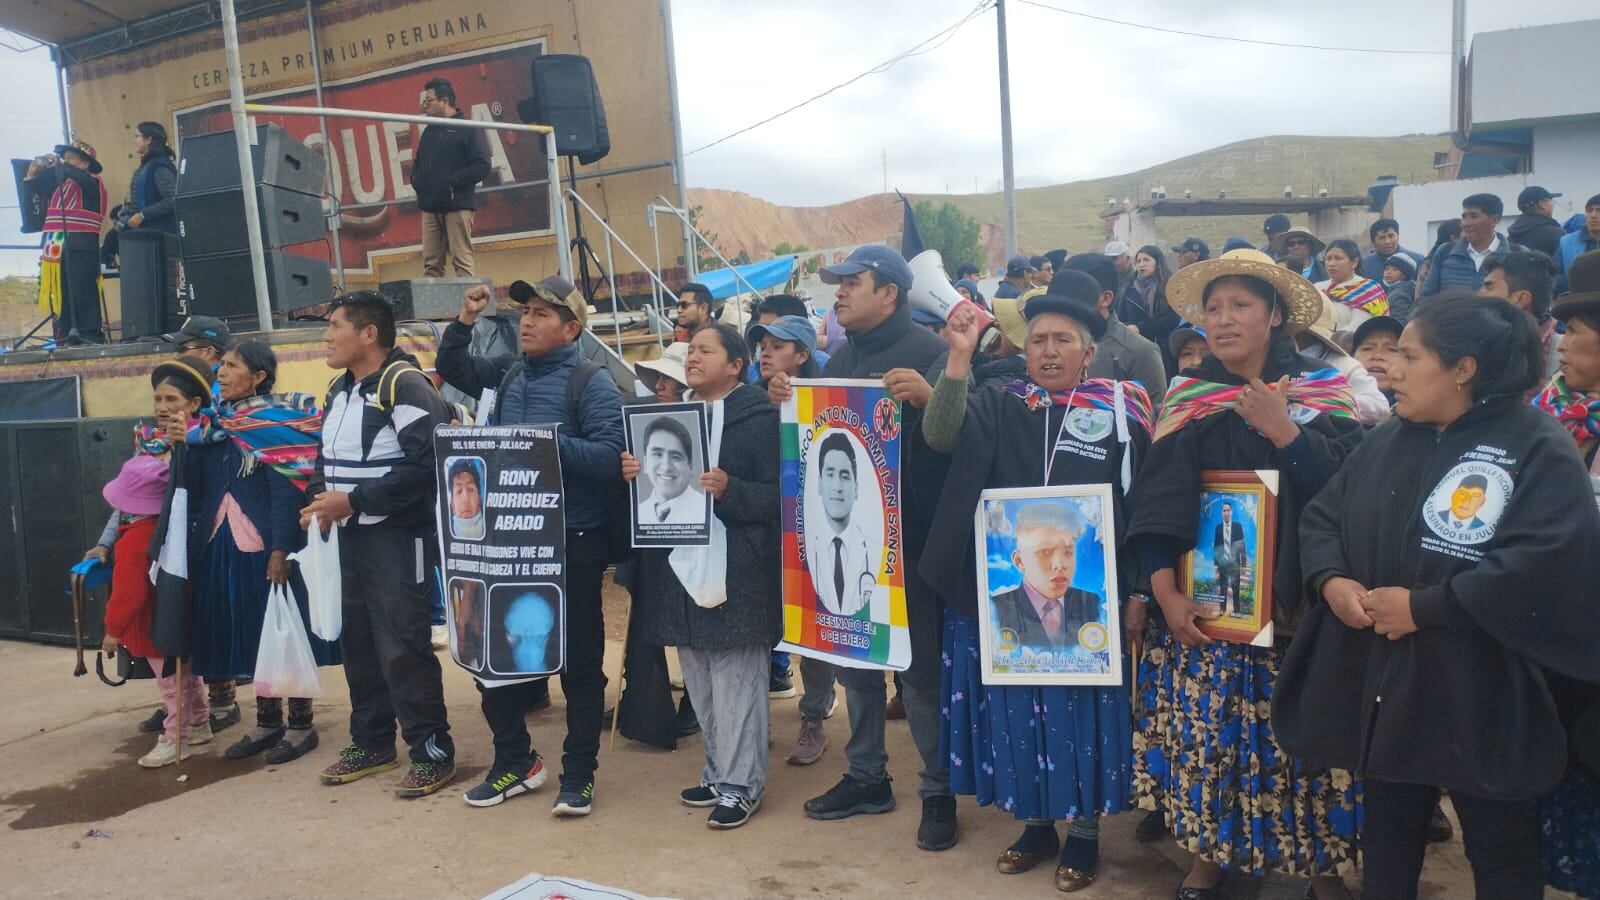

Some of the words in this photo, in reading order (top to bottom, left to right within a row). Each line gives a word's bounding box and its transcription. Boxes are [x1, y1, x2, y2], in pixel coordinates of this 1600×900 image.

[193, 60, 270, 89] CEREZA
[386, 13, 487, 49] PERUANA
[519, 428, 554, 440] VICTIMAS
[452, 441, 463, 450] DEL
[467, 441, 476, 450] DE
[477, 441, 495, 450] ENERO
[499, 470, 540, 486] RONY
[813, 405, 860, 431] ANTONIO
[860, 423, 897, 508] SAMILLAN
[884, 513, 898, 575] SANGA
[486, 492, 560, 508] RODRIGUEZ
[494, 515, 545, 531] ABADO
[520, 546, 537, 558] VIVE
[538, 546, 554, 558] CON
[489, 563, 512, 576] CABEZA
[515, 564, 521, 576] Y
[522, 564, 531, 575] EL
[532, 563, 561, 576] CUERPO
[816, 612, 861, 632] ASESINADO
[821, 628, 826, 640] 9
[826, 630, 839, 643] DE
[840, 632, 870, 649] ENERO
[1003, 632, 1012, 640] 16
